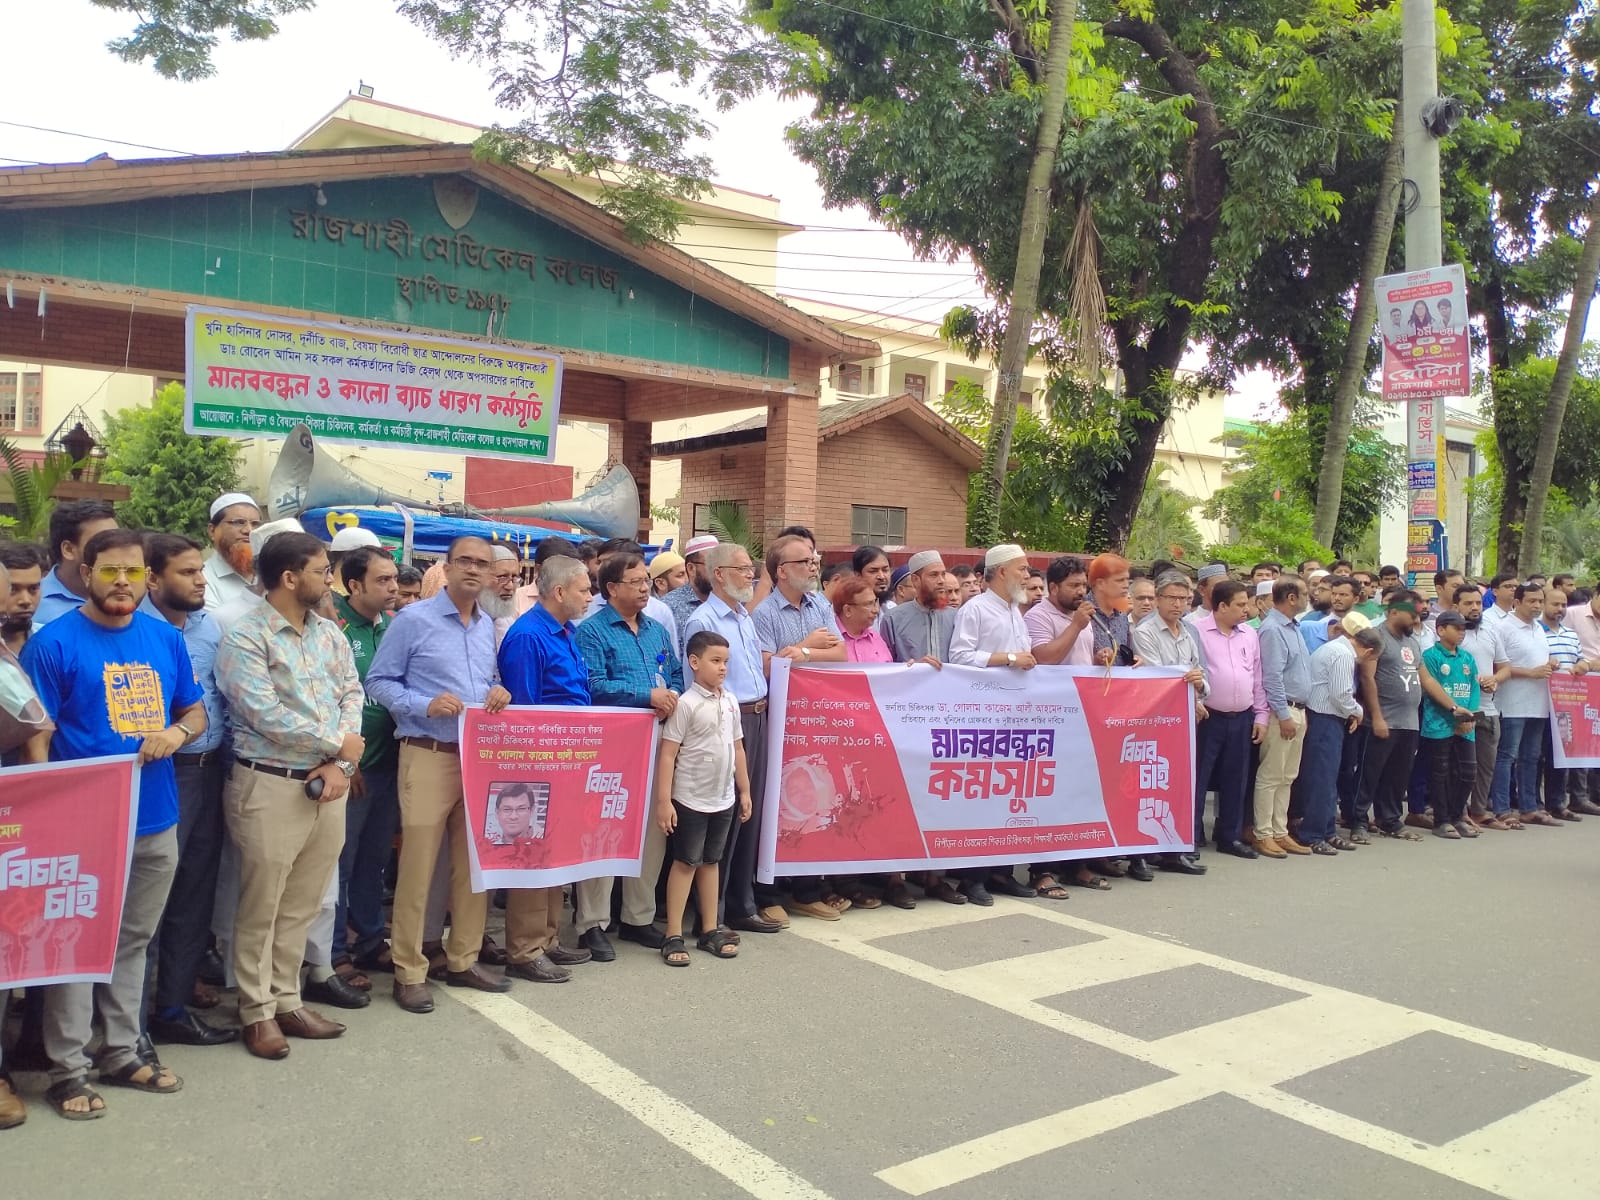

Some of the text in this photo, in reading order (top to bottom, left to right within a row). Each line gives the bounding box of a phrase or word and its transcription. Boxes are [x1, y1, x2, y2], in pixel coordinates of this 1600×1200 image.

[289, 209, 619, 293] রাজশাহী মেডিকেল কলেজ
[205, 319, 222, 336] খুনি
[226, 322, 262, 340] হাসিনার
[266, 329, 295, 346] দোসর,
[329, 336, 350, 351] বাজ,
[352, 337, 377, 353] বৈষম্য
[381, 339, 410, 357] বিরোধী
[413, 347, 428, 360] ছাত্র
[431, 350, 475, 366] আন্দোলনের
[478, 352, 504, 369] বিরুদ্ধে
[506, 358, 549, 376] অবস্থানকারী
[239, 344, 270, 360] রোবেদ
[274, 347, 301, 363] আমিন
[305, 353, 318, 366] সহ
[322, 353, 343, 368] সকল
[346, 354, 393, 373] কর্মকর্তাদের
[396, 358, 416, 374] ডিজি
[444, 368, 464, 382] থেকে
[467, 371, 508, 387] অপসারণের
[510, 375, 536, 391] দাবিতে
[1388, 362, 1464, 381] রেটিনা
[207, 365, 544, 428] মানববন্ধন ও কালো ব্যাচ ধারণ কর্মসূচি
[358, 420, 381, 436] কর্মকর্তা
[390, 423, 412, 438] কর্মচারী
[812, 698, 845, 710] মেডিকেল
[848, 701, 871, 711] কলেজ
[953, 703, 981, 714] গোলাম
[984, 703, 1012, 714] কাজেম
[1015, 701, 1032, 714] আলী
[813, 734, 839, 746] সকাল
[843, 736, 871, 747] ১১.০০
[874, 733, 886, 747] মি.
[832, 718, 855, 729] ২০২৪
[497, 749, 525, 761] গোলাম
[528, 751, 554, 761] কাজেম
[930, 728, 1055, 761] মানববন্ধন
[1119, 733, 1157, 764] বিচার
[584, 763, 623, 796] বিচার
[928, 751, 1056, 813] কর্মসূচি
[1139, 756, 1170, 790] চাই
[601, 787, 629, 820] চাই
[0, 847, 79, 890] বিচার
[44, 874, 99, 920] চাই
